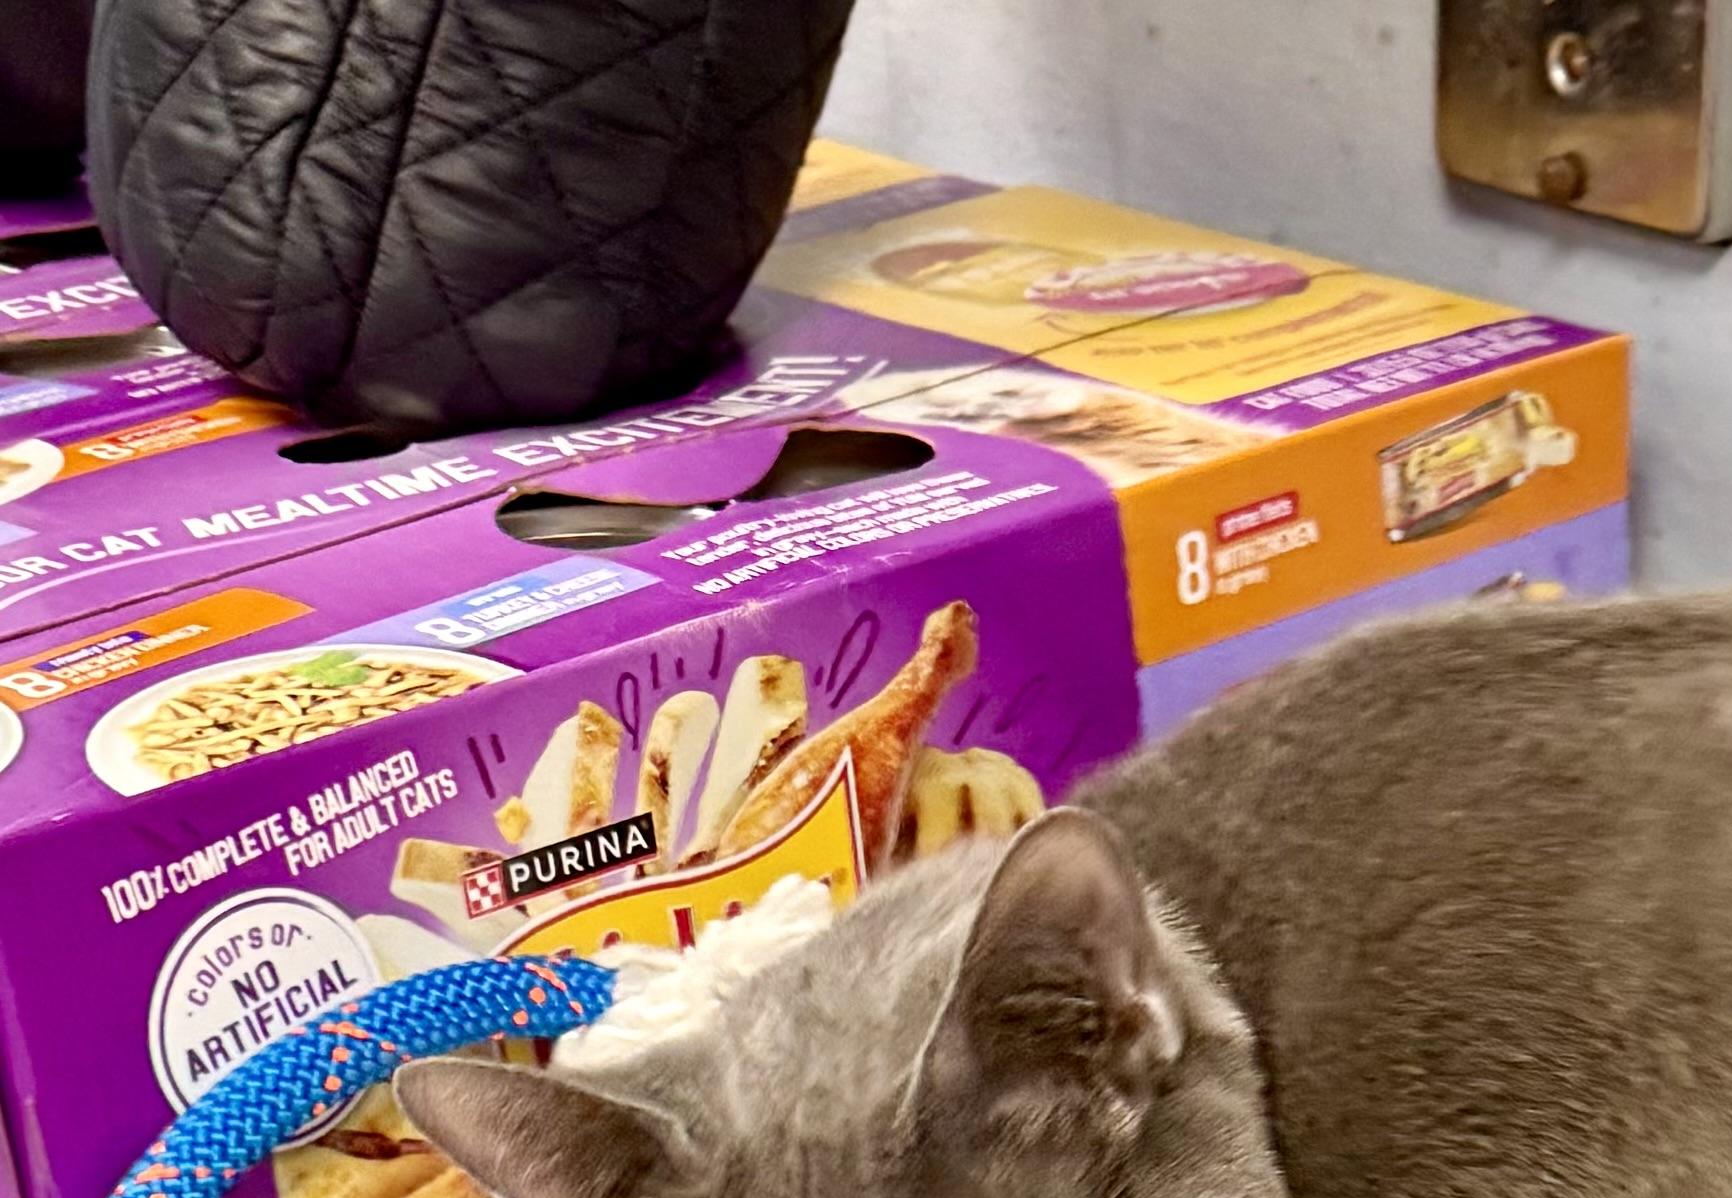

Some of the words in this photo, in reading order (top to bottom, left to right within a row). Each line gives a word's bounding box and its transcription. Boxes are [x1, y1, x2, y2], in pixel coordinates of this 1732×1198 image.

[59, 527, 163, 562] CAT
[183, 456, 499, 539] MEALTIME
[1175, 530, 1210, 605] 8
[413, 617, 486, 645] 8
[0, 671, 68, 698] 8
[101, 865, 170, 924] 100%
[166, 813, 290, 894] COMPLETE
[287, 805, 311, 836] &
[307, 750, 420, 825] BALANCED
[284, 831, 335, 876] FOR
[332, 795, 400, 855] ADULT
[399, 768, 459, 818] CATS
[507, 823, 649, 894] PURINA
[185, 959, 359, 1083] ARTIFICIAL
[231, 959, 280, 1009] NO
